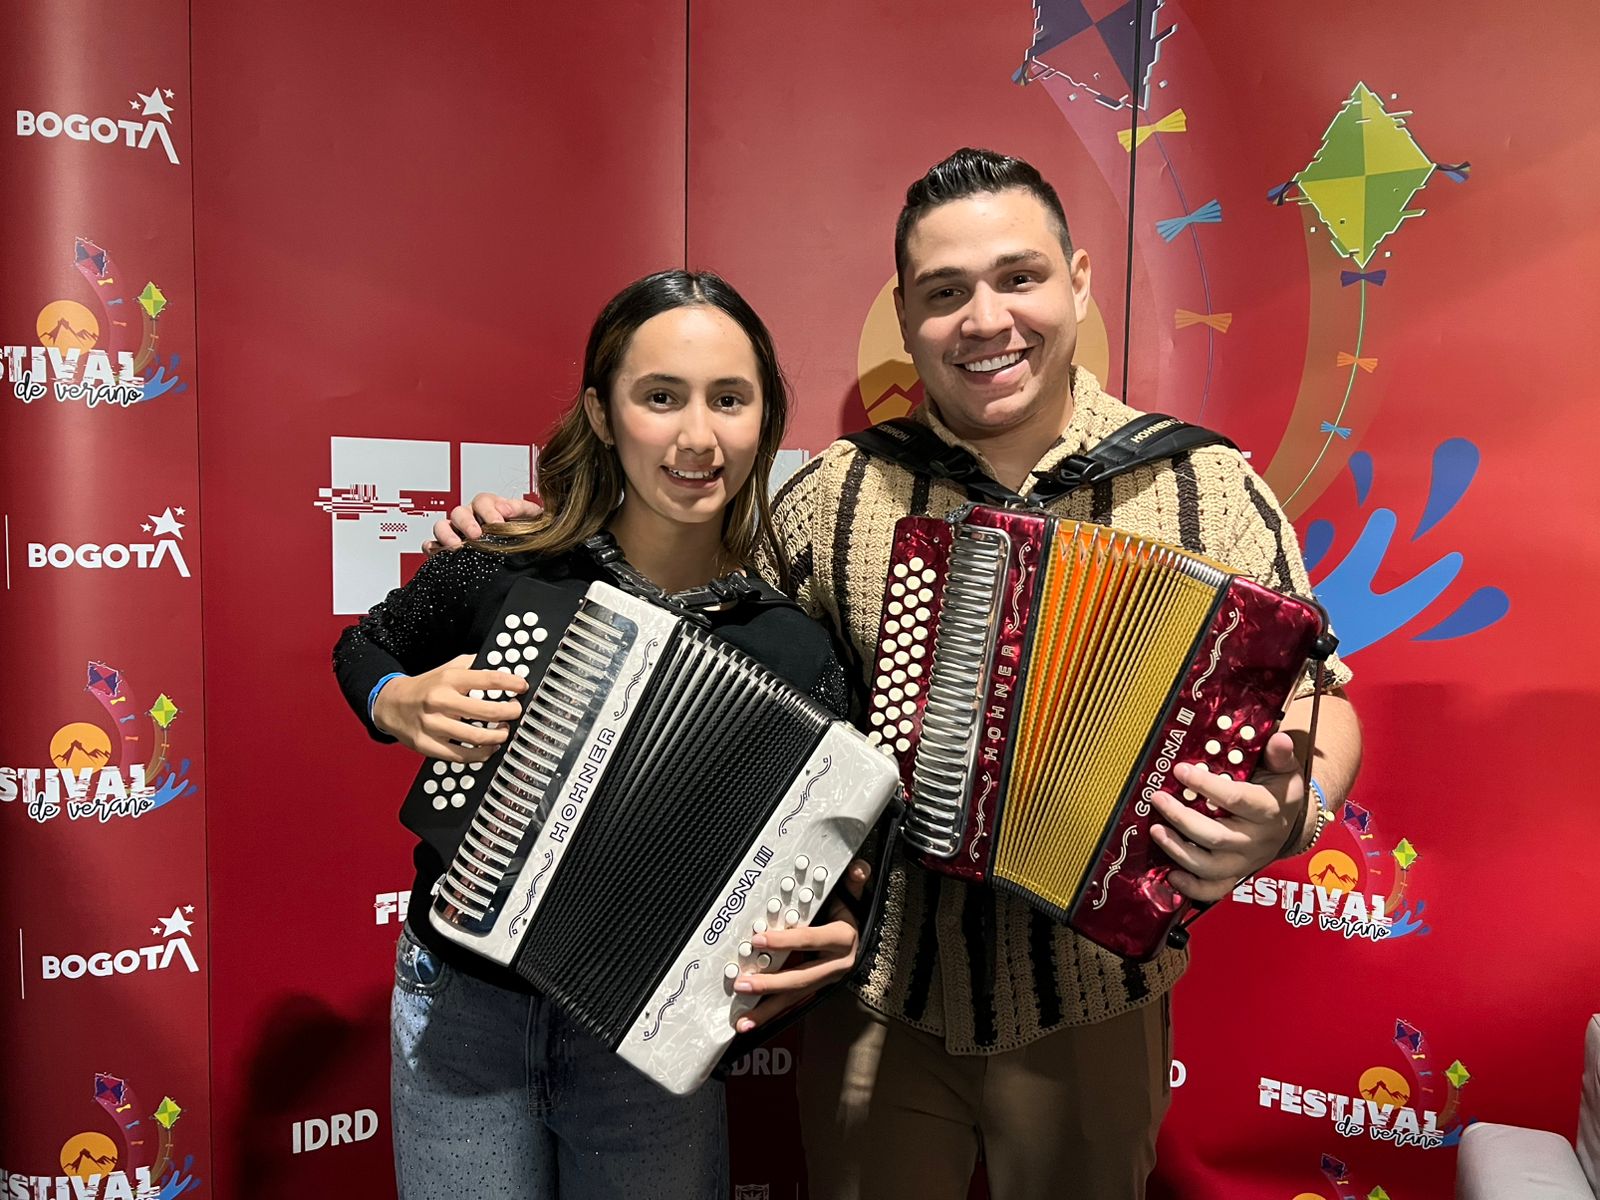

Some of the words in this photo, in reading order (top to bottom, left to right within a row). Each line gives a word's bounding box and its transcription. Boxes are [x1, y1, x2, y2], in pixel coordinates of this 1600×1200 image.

[0, 346, 144, 389] TIVAL
[14, 371, 47, 403] de
[54, 381, 144, 408] verano
[983, 645, 1016, 761] HOHNER
[1135, 729, 1187, 817] CORONA
[1176, 706, 1196, 726] III
[28, 791, 60, 823] de
[67, 798, 156, 823] verano
[550, 728, 616, 843] HOHNER
[703, 866, 761, 945] CORONA
[753, 845, 774, 868] III
[1285, 902, 1313, 928] de
[1319, 914, 1392, 942] verano
[1258, 1077, 1444, 1139] FESTIVAL
[292, 1109, 379, 1154] IDRD
[1335, 1115, 1364, 1137] de
[1370, 1125, 1443, 1149] verano
